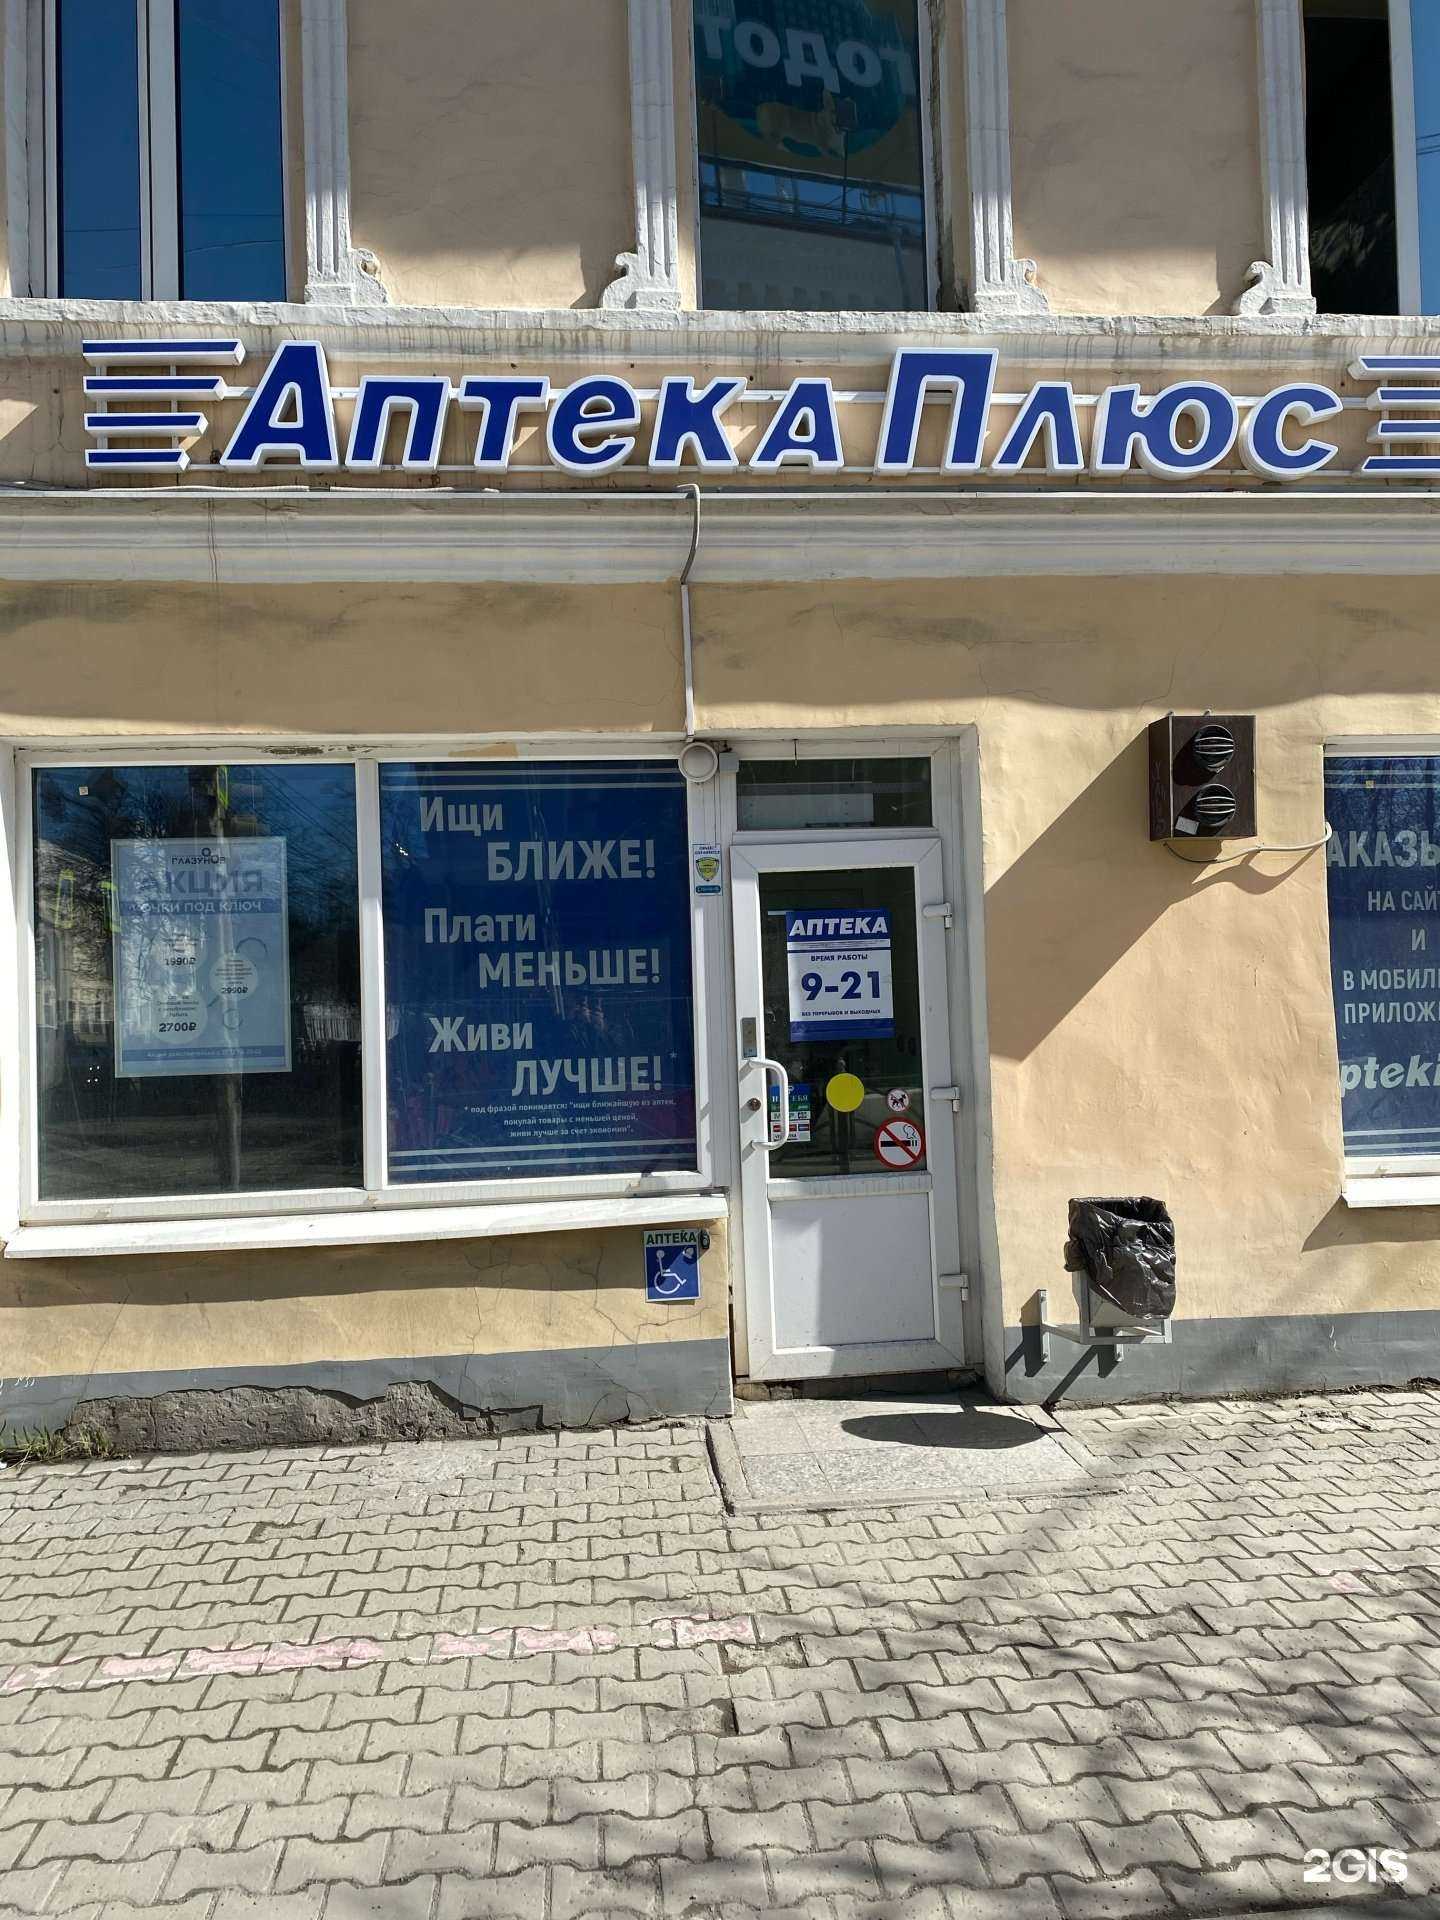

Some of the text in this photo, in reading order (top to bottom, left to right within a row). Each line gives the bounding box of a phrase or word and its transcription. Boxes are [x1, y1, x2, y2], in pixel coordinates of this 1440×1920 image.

[419, 796, 503, 836] Ищи
[487, 839, 656, 881] БЛИЖЕ!
[184, 902, 215, 912] ПОД
[1367, 890, 1396, 911] НА
[424, 907, 536, 943] Плати
[789, 916, 888, 936] АПТЕКА
[1411, 928, 1426, 951] И
[479, 949, 660, 989] МЕНЬШЕ!
[810, 953, 868, 962] ВРЕМЯ РАБОТЫ
[801, 970, 881, 1001] 9-21
[1343, 970, 1355, 991] В
[1344, 1001, 1440, 1024] ПРИЛОЖ
[429, 1016, 533, 1052] Живи
[512, 1055, 662, 1097] ЛУЧШЕ!
[487, 1103, 517, 1114] фразой
[504, 1116, 537, 1127] покупай
[538, 1117, 567, 1125] товары
[646, 1231, 697, 1245] АПТЕКА
